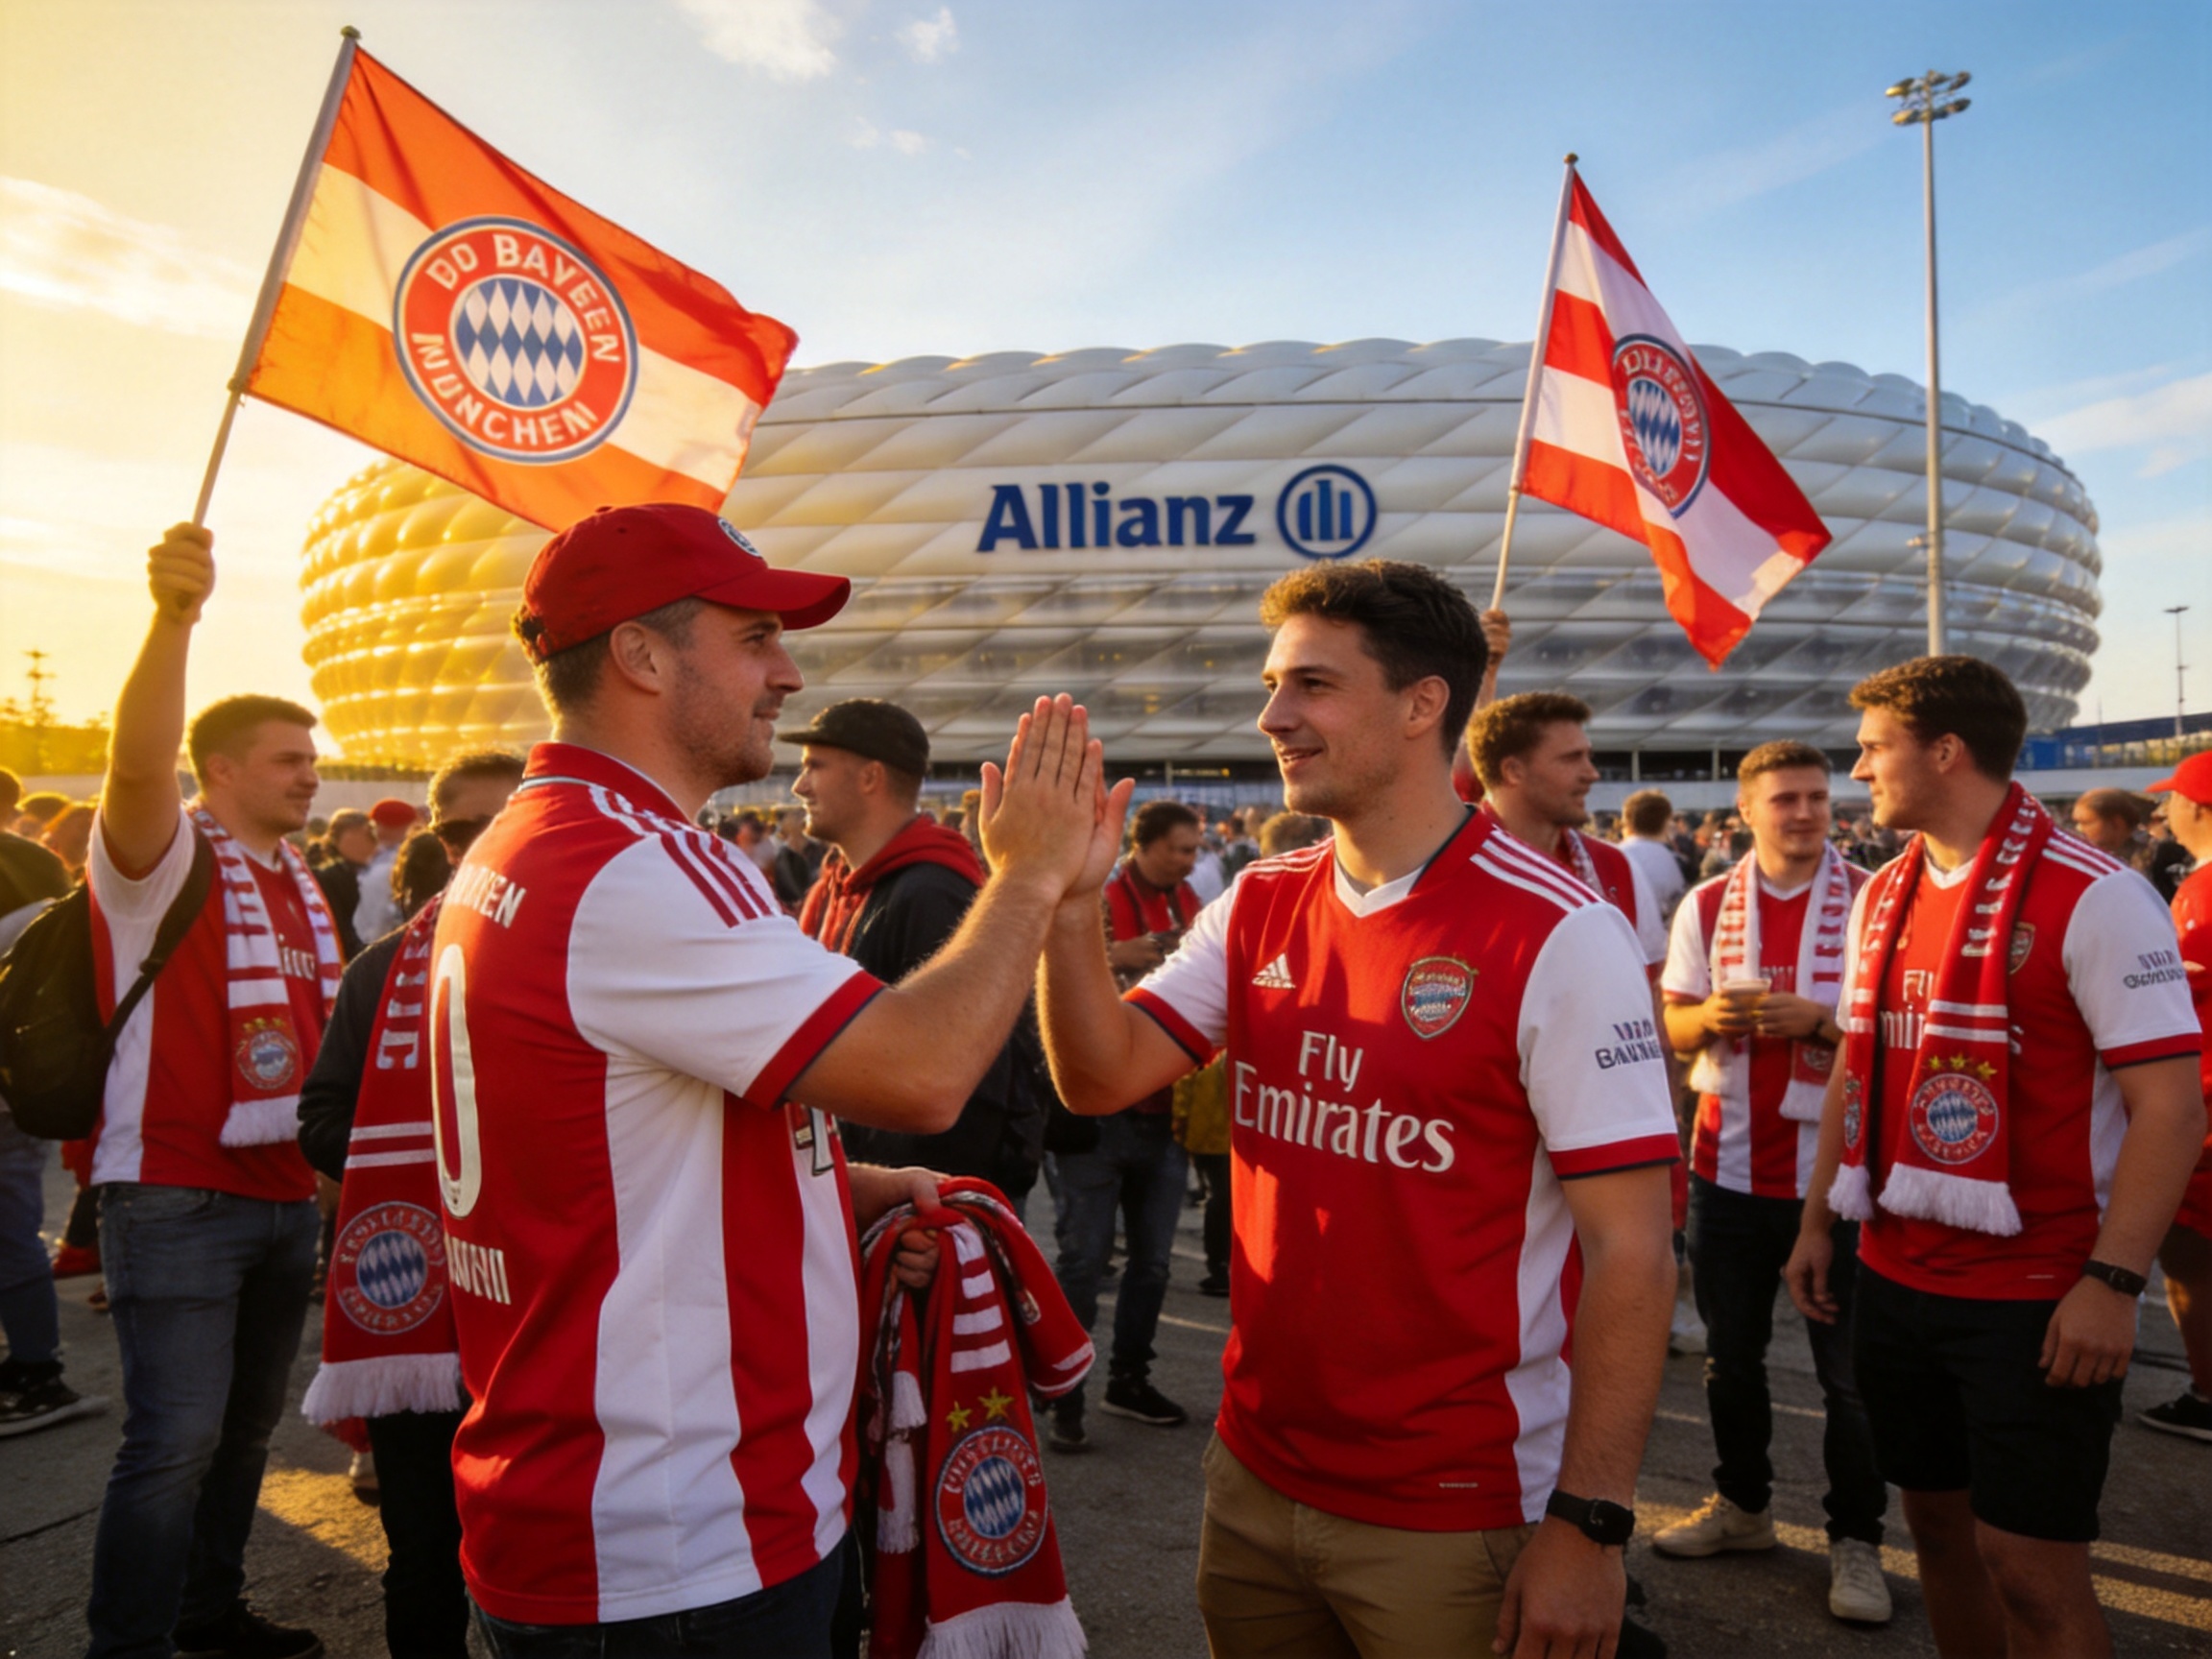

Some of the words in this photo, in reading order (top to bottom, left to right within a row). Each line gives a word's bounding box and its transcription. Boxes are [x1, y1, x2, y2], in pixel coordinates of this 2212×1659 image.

[976, 481, 1256, 552] Allianz
[1298, 1030, 1363, 1093] Fly
[1235, 1060, 1455, 1173] Emirates
